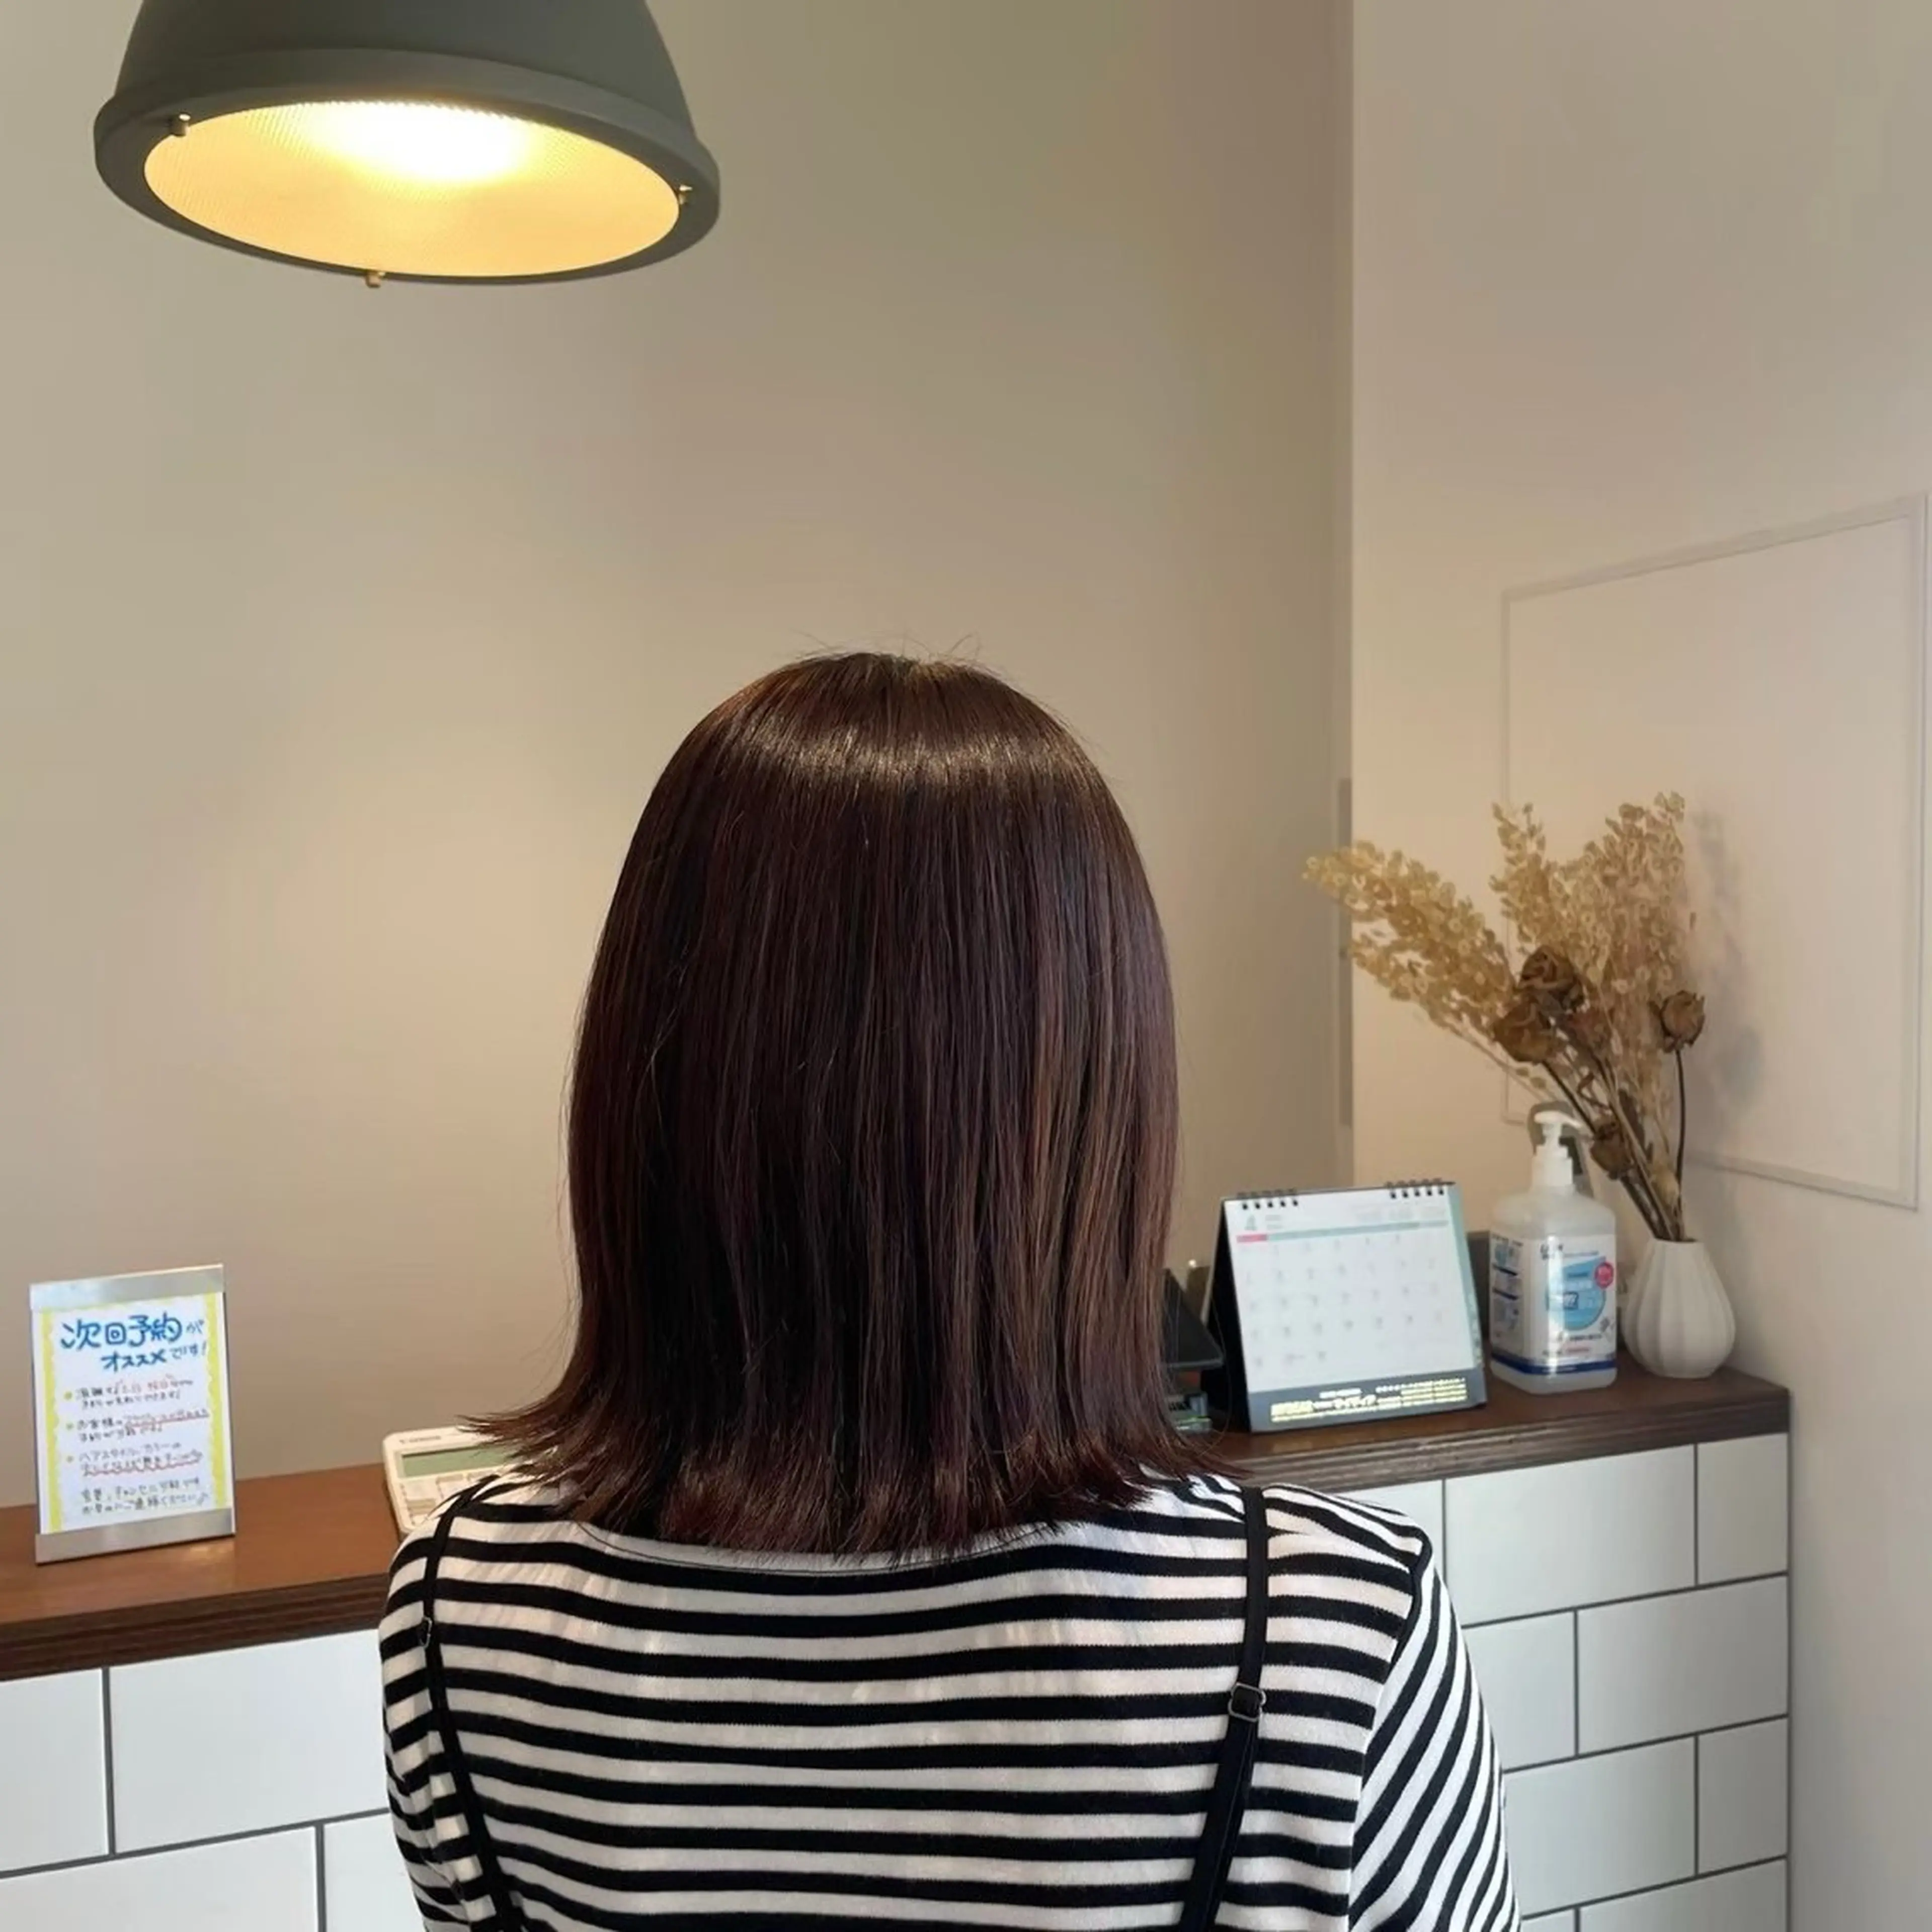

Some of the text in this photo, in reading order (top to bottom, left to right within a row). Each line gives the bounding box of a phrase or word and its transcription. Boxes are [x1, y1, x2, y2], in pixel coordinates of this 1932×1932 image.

[60, 1312, 204, 1350] 次回予約が
